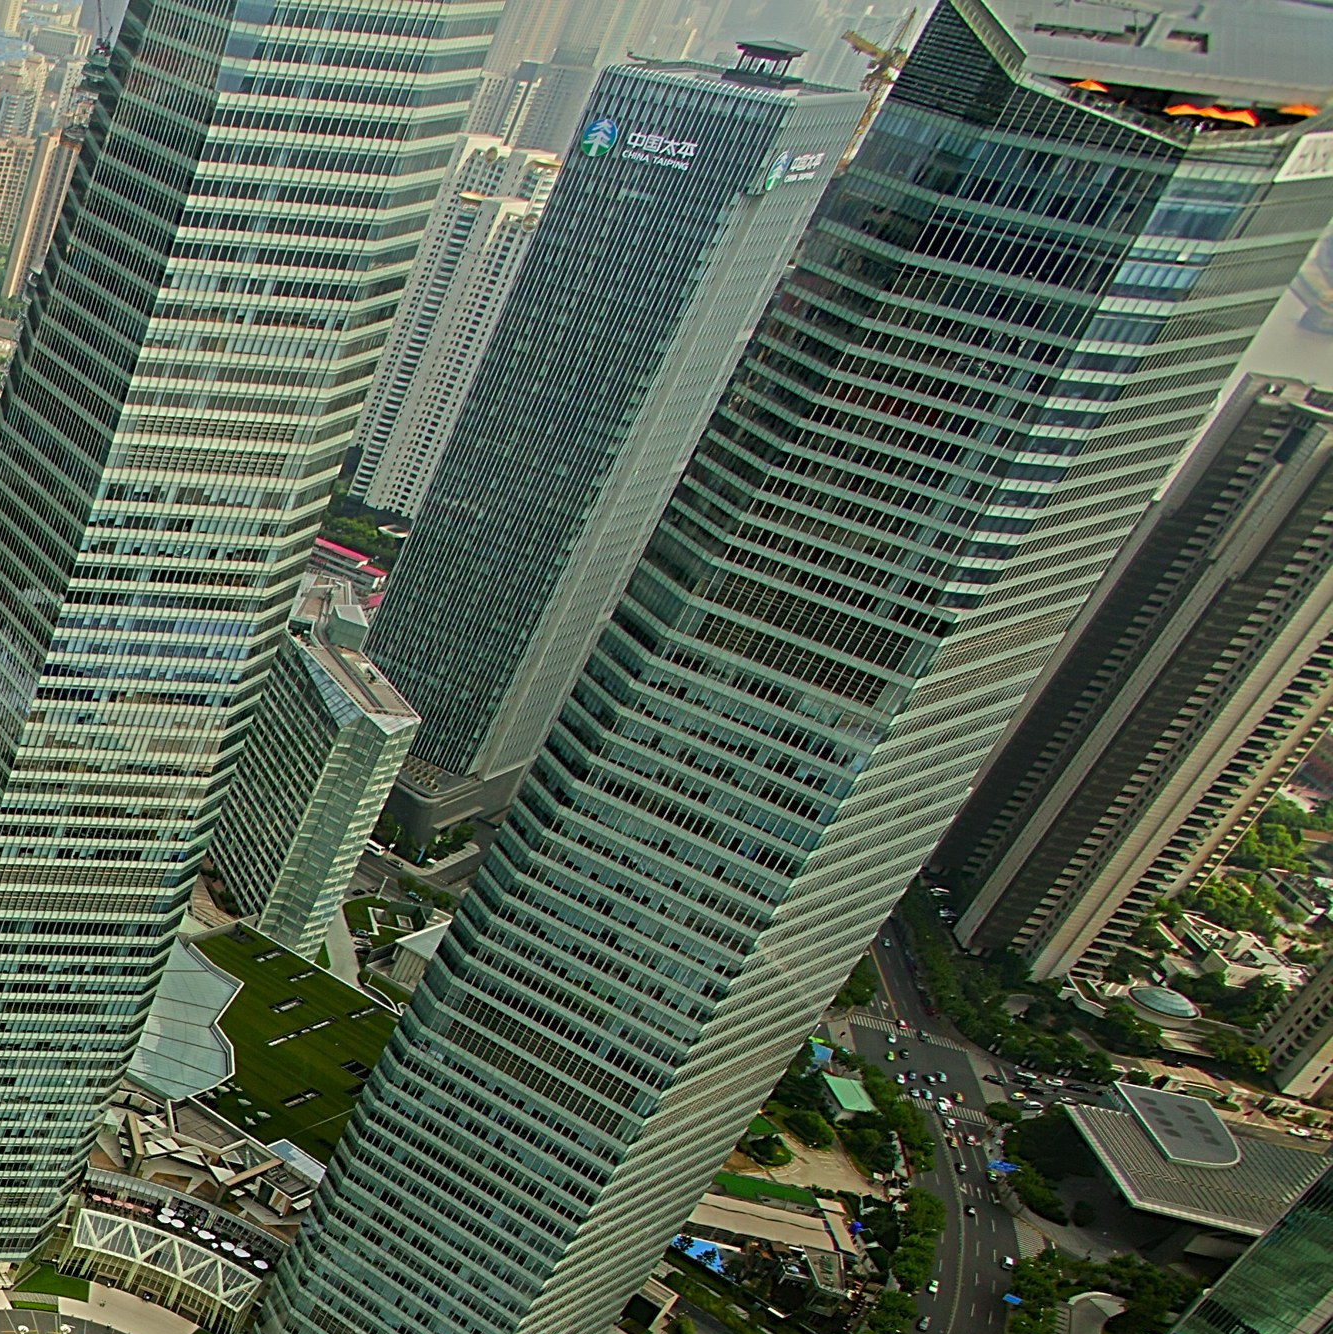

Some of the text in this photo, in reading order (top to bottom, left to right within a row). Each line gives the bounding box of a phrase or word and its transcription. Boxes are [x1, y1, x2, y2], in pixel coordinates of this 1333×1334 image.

[627, 131, 698, 158] 中国太平
[622, 150, 690, 171] CHINA TAIPING
